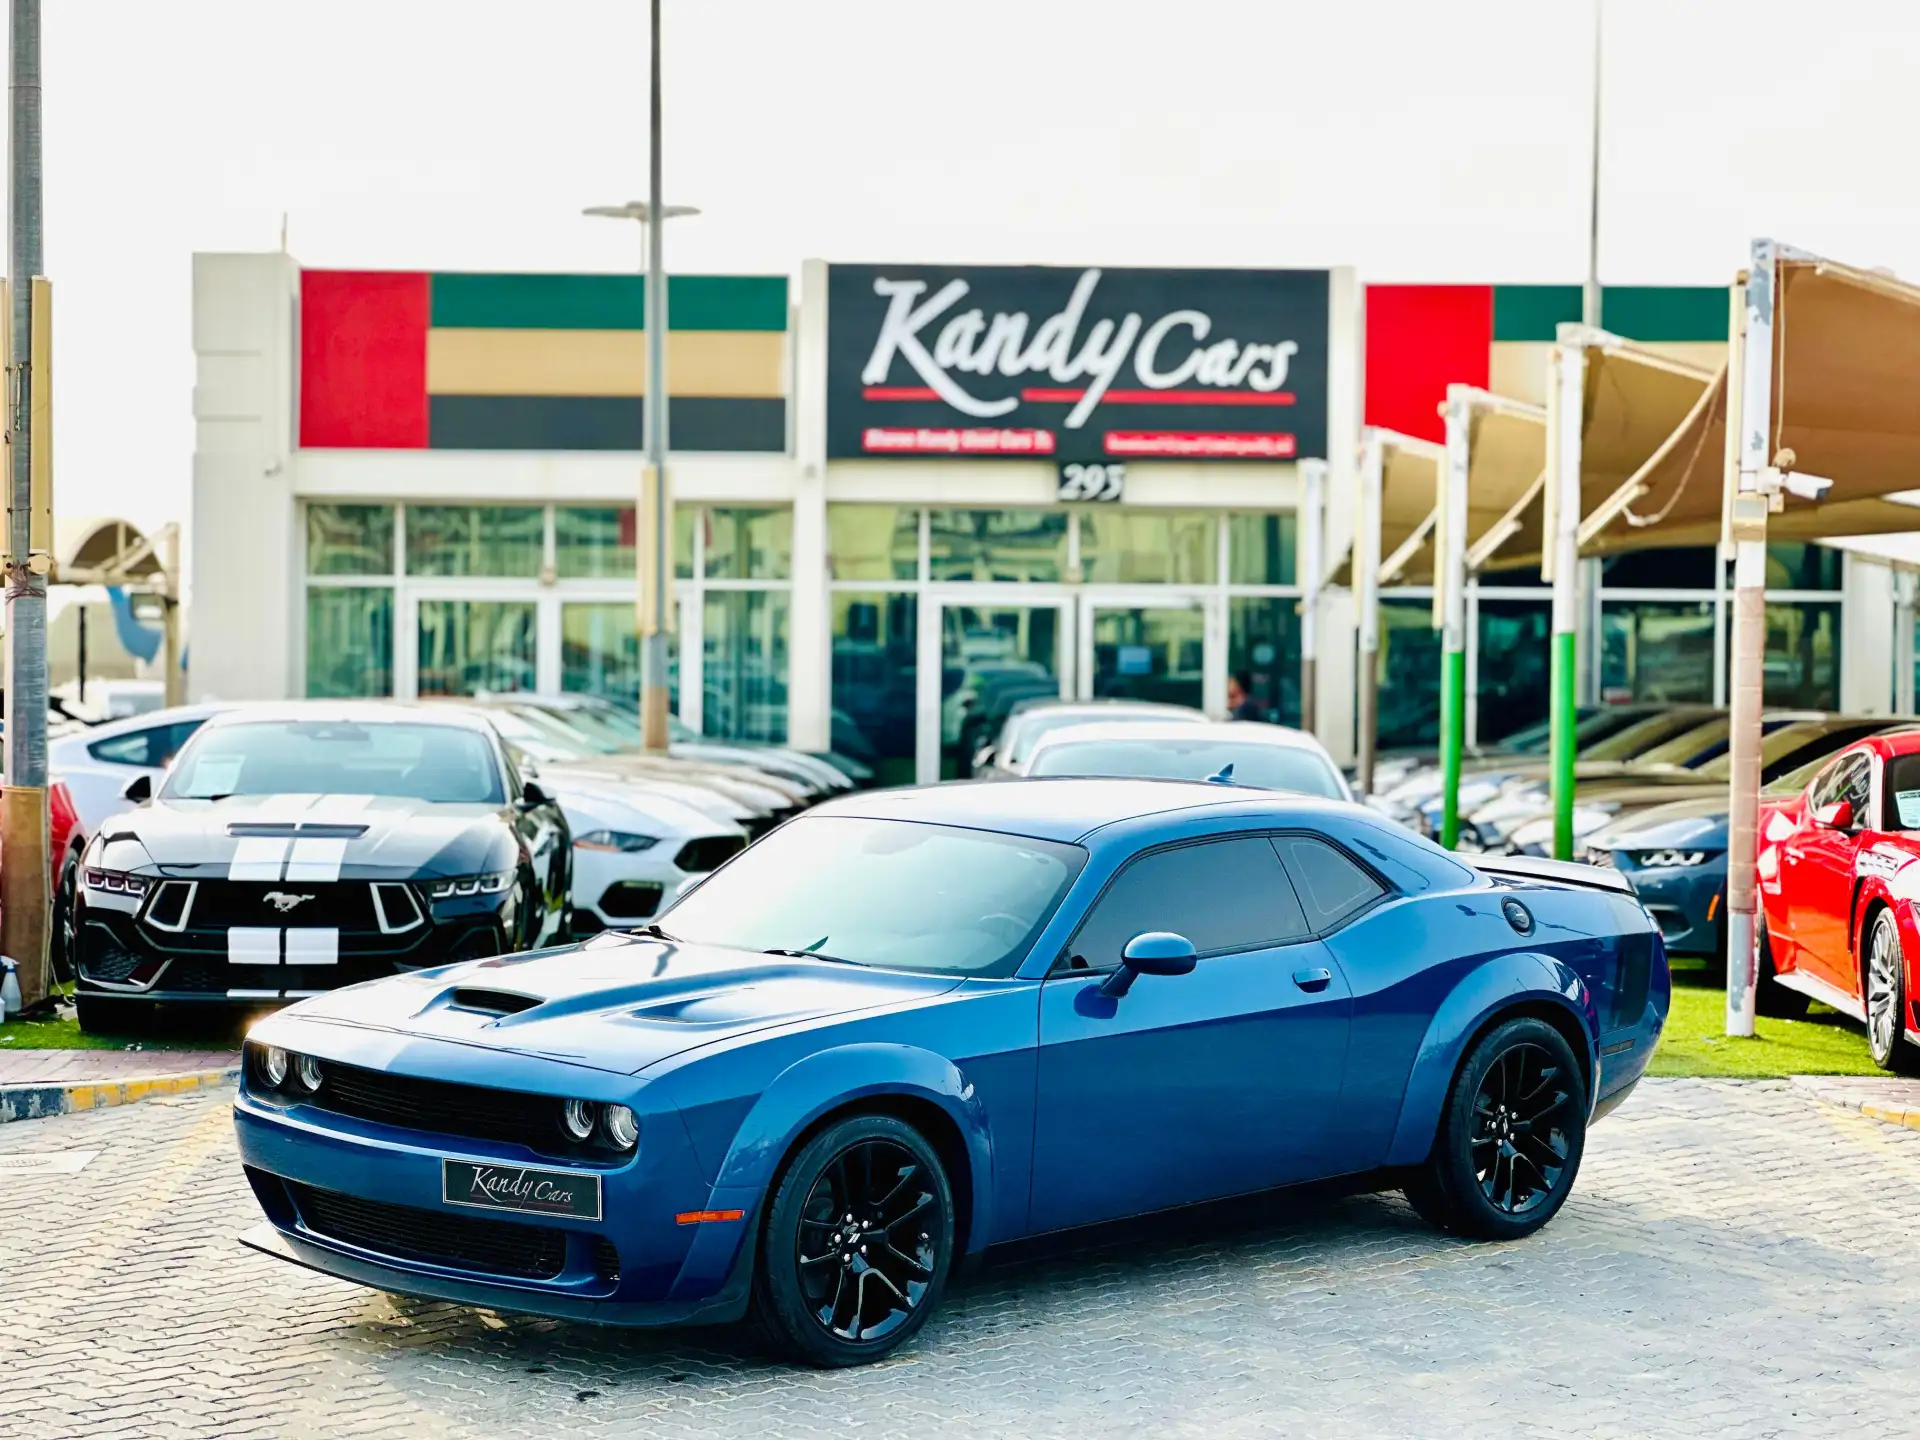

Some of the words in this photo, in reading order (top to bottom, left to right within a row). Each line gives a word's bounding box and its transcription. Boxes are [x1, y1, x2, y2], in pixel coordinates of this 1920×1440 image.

[862, 267, 1142, 429] Kandy
[1134, 310, 1298, 392] Cars
[1057, 463, 1126, 501] 295
[469, 1166, 534, 1208] Kandy
[534, 1181, 573, 1203] Cars
